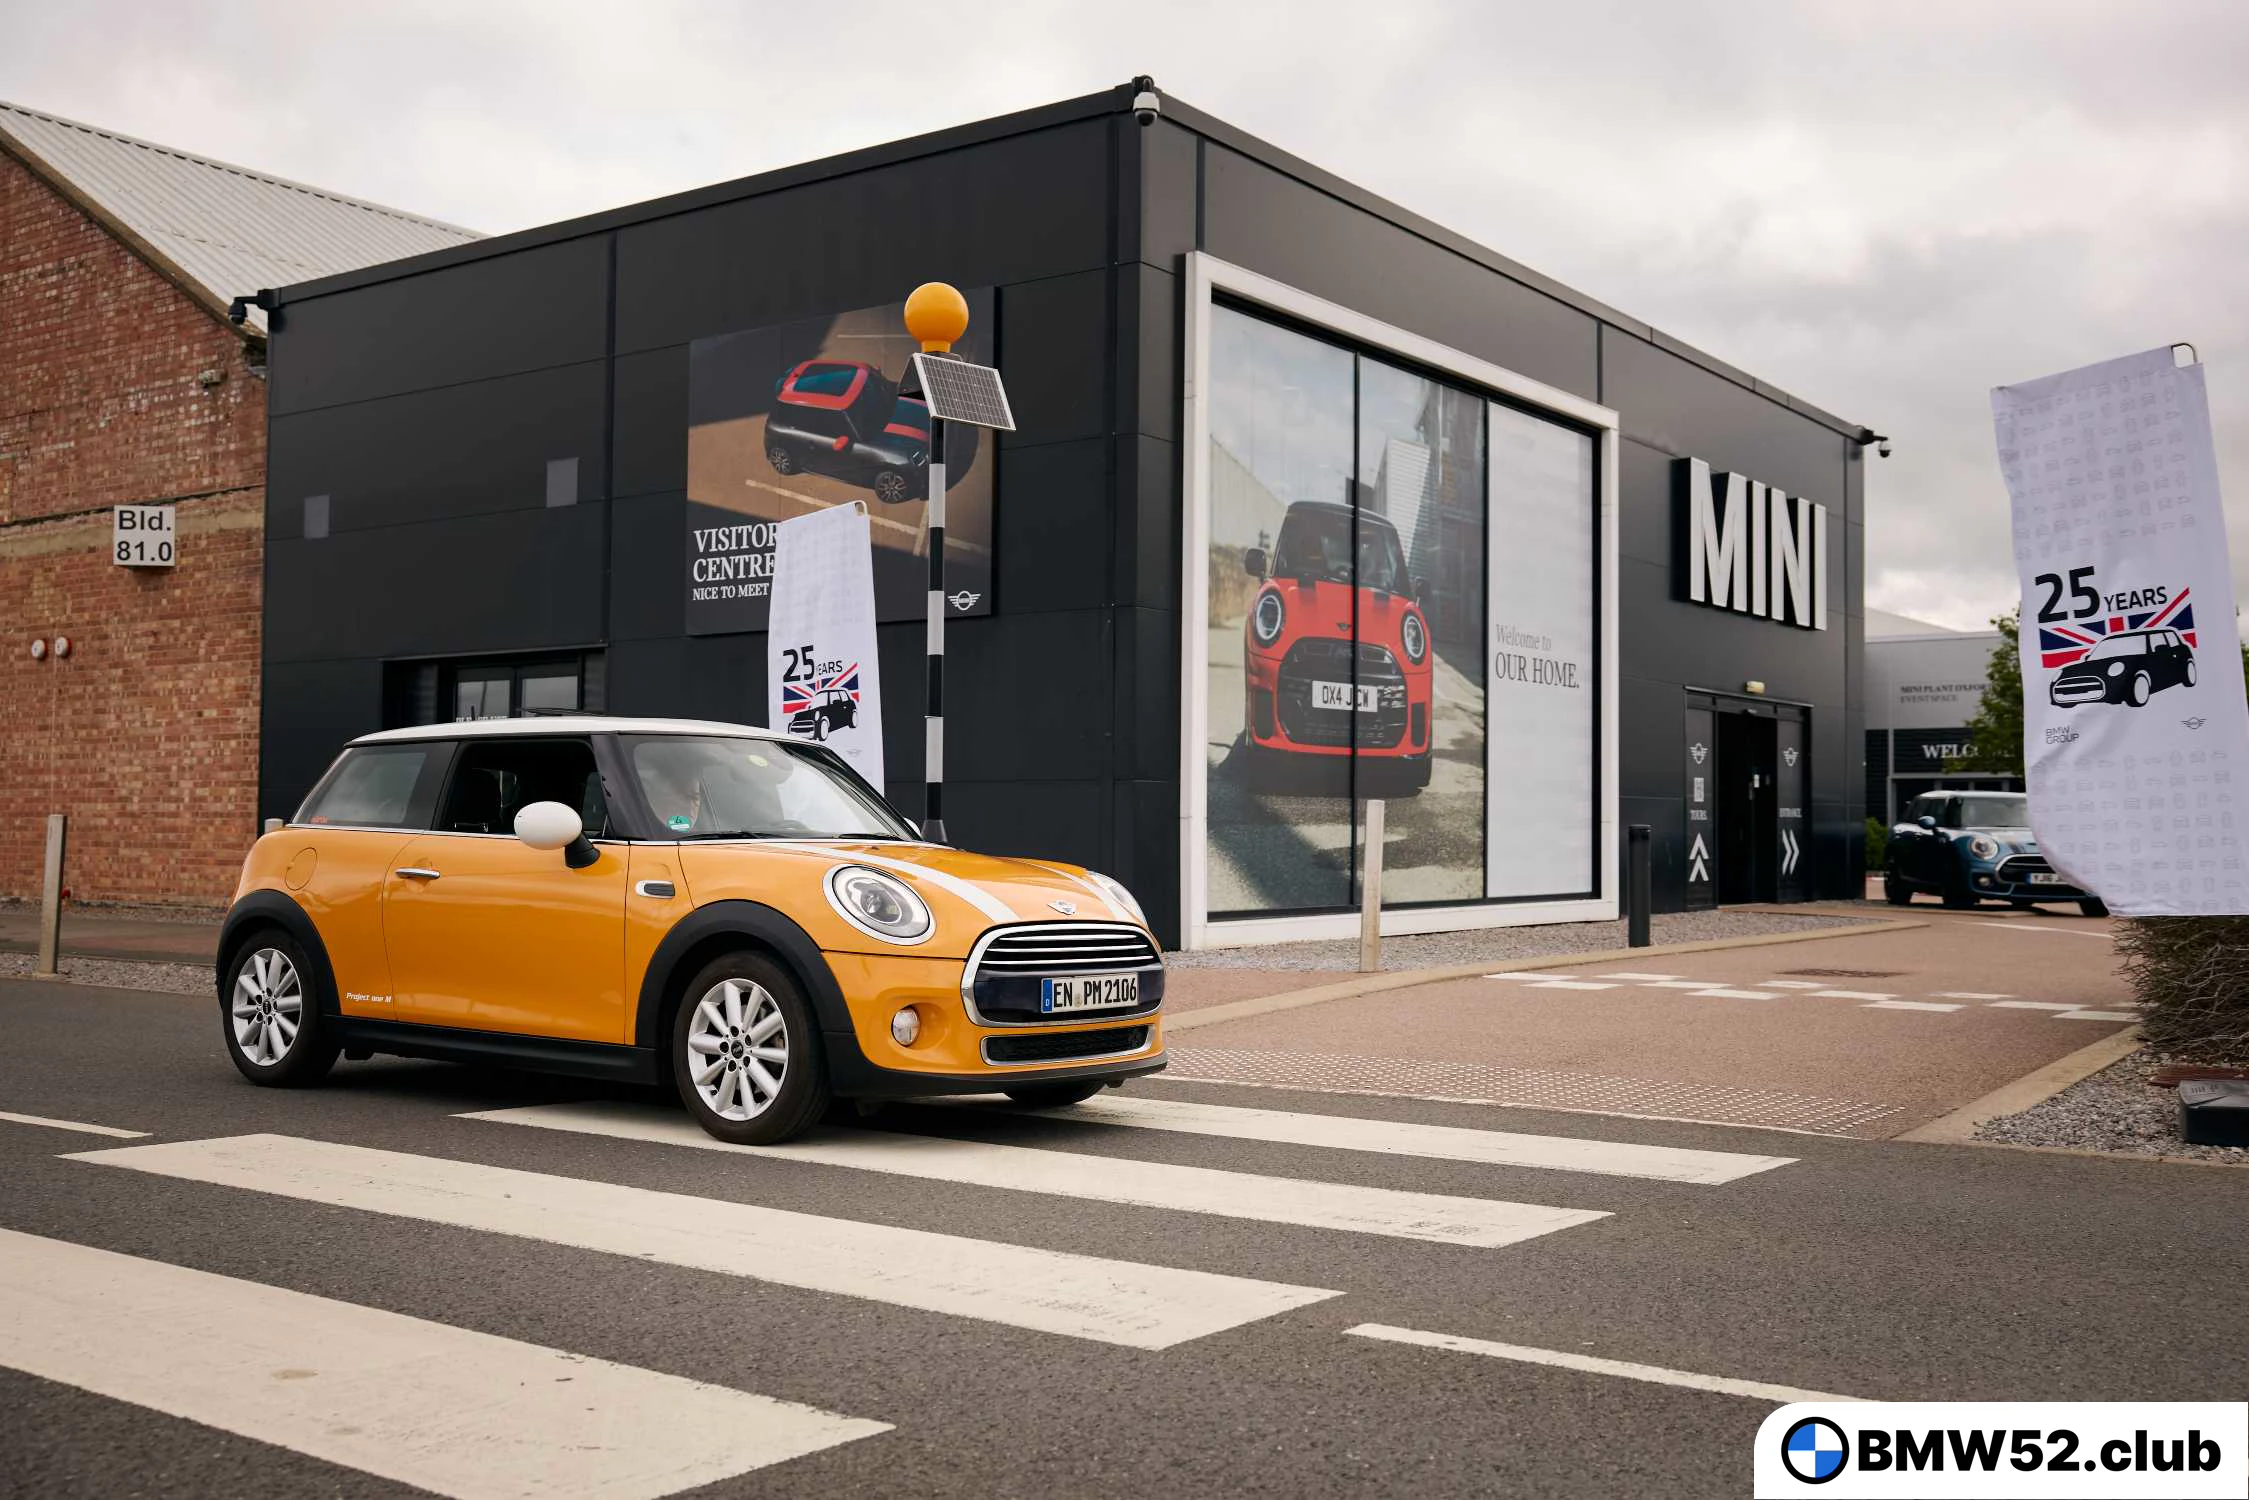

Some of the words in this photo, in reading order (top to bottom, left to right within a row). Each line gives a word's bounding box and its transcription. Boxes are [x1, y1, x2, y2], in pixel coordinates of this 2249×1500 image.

[119, 510, 171, 531] Bld.
[117, 541, 172, 562] 81.0
[1689, 456, 1828, 631] MINI
[693, 552, 776, 582] CENTRE
[693, 586, 719, 601] NICE
[720, 585, 736, 599] TO
[738, 582, 769, 598] MEET
[2035, 566, 2101, 624] 25
[2103, 586, 2168, 612] YEARS
[1496, 623, 1540, 650] Welcome
[1542, 634, 1552, 651] to
[783, 645, 815, 682] 25
[1495, 652, 1528, 682] OUR
[1532, 657, 1580, 689] HOME.
[1053, 982, 1073, 1008] EN
[1083, 979, 1102, 1006] PM
[1104, 977, 1137, 1004] 2106
